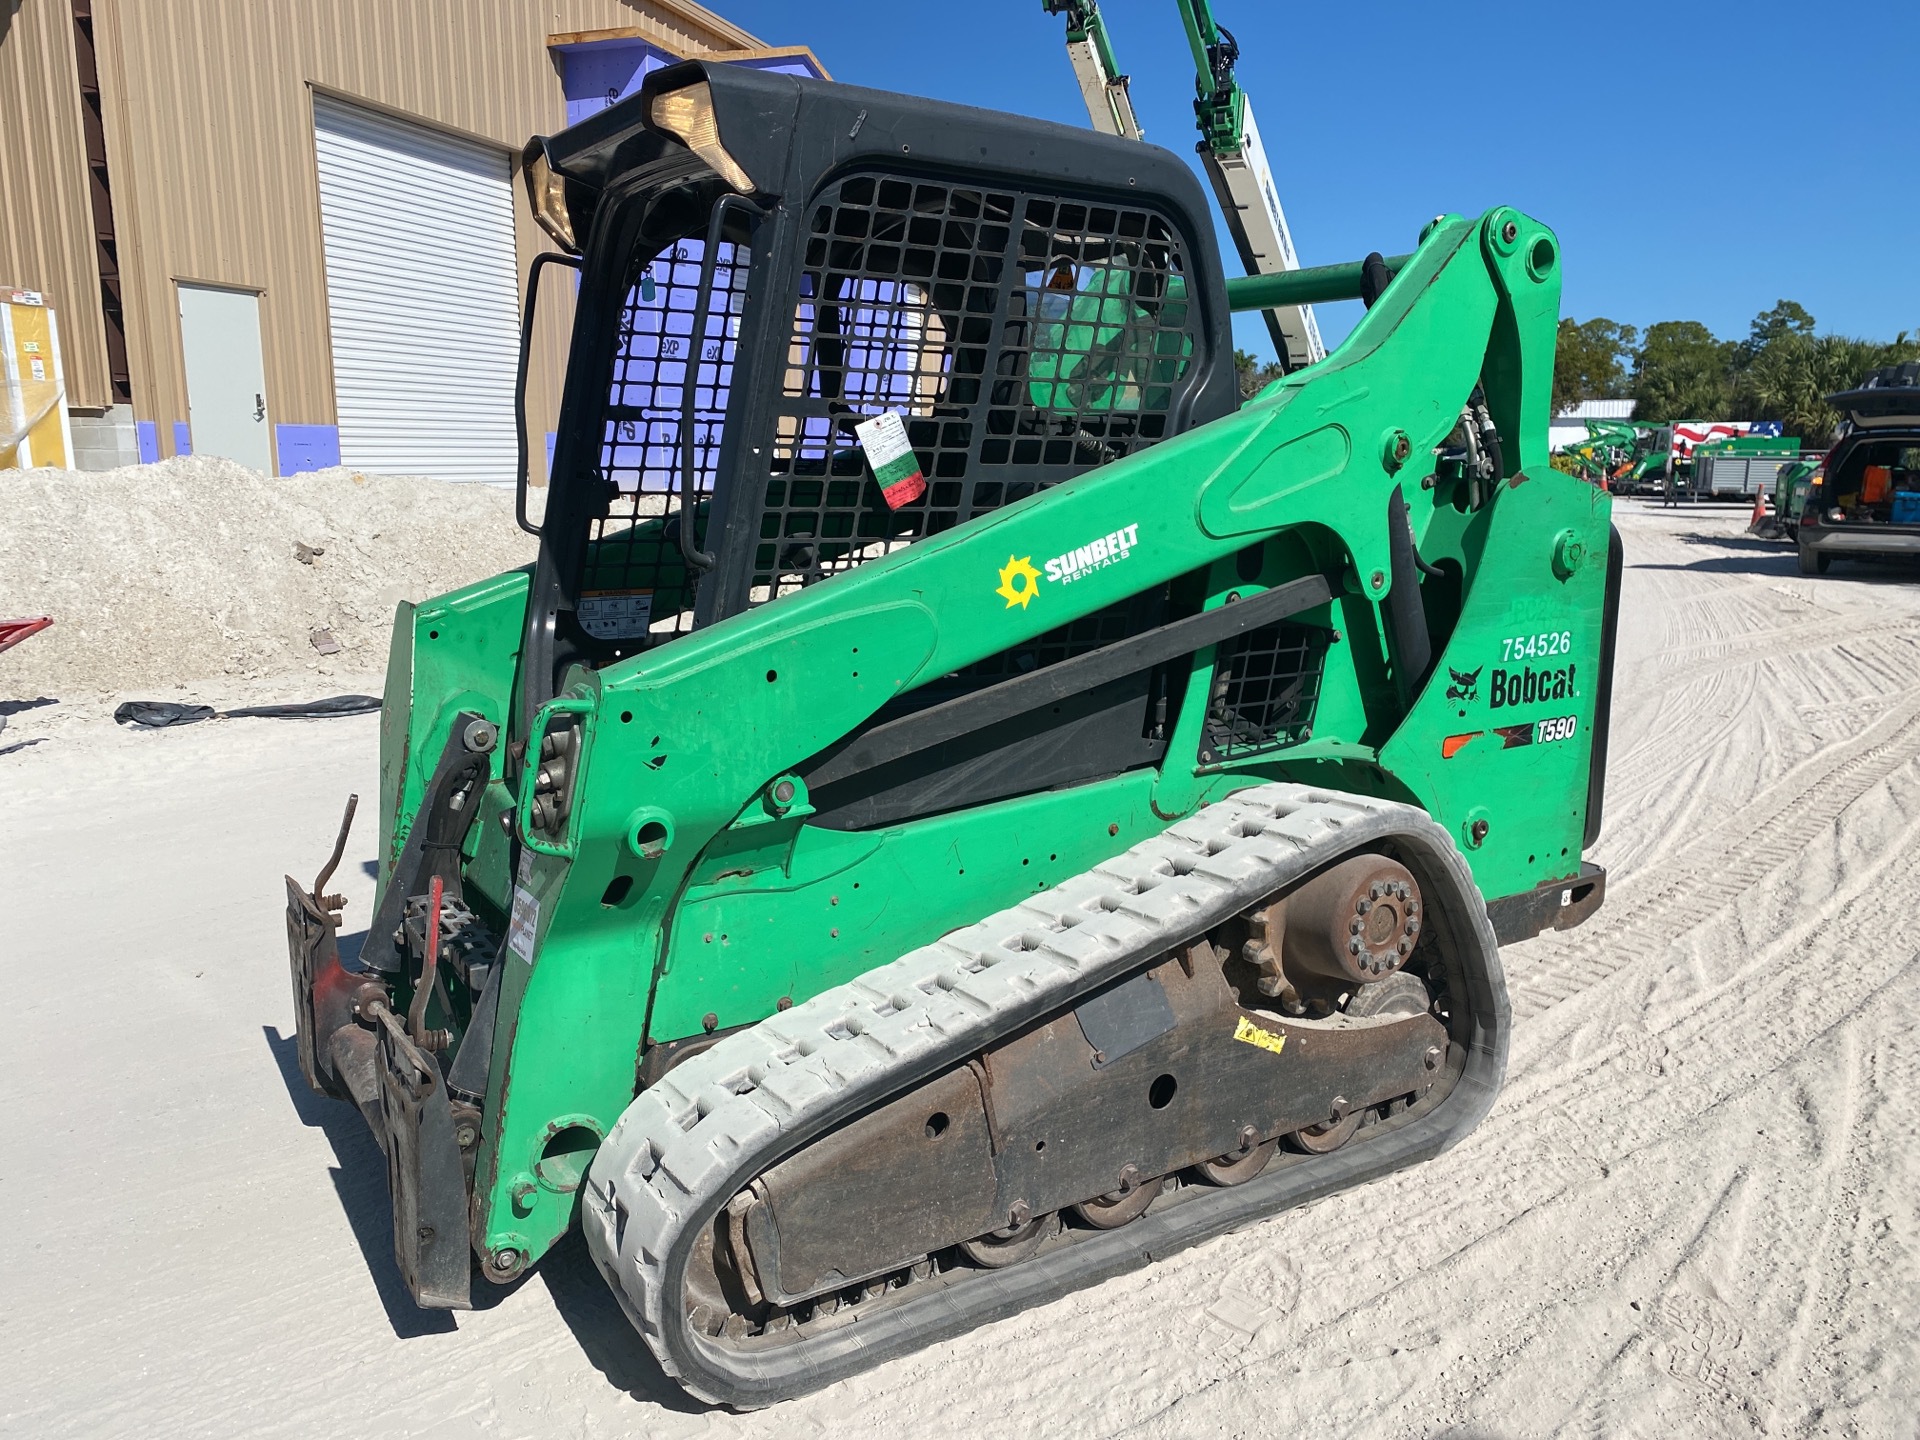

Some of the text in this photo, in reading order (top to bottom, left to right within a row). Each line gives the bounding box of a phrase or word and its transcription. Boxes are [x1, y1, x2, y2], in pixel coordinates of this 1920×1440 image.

[1044, 522, 1139, 583] SUNBELT
[1061, 549, 1131, 586] RENTALS
[1502, 630, 1571, 663] 754526
[1489, 663, 1576, 709] Bobcat
[1537, 714, 1578, 745] T590
